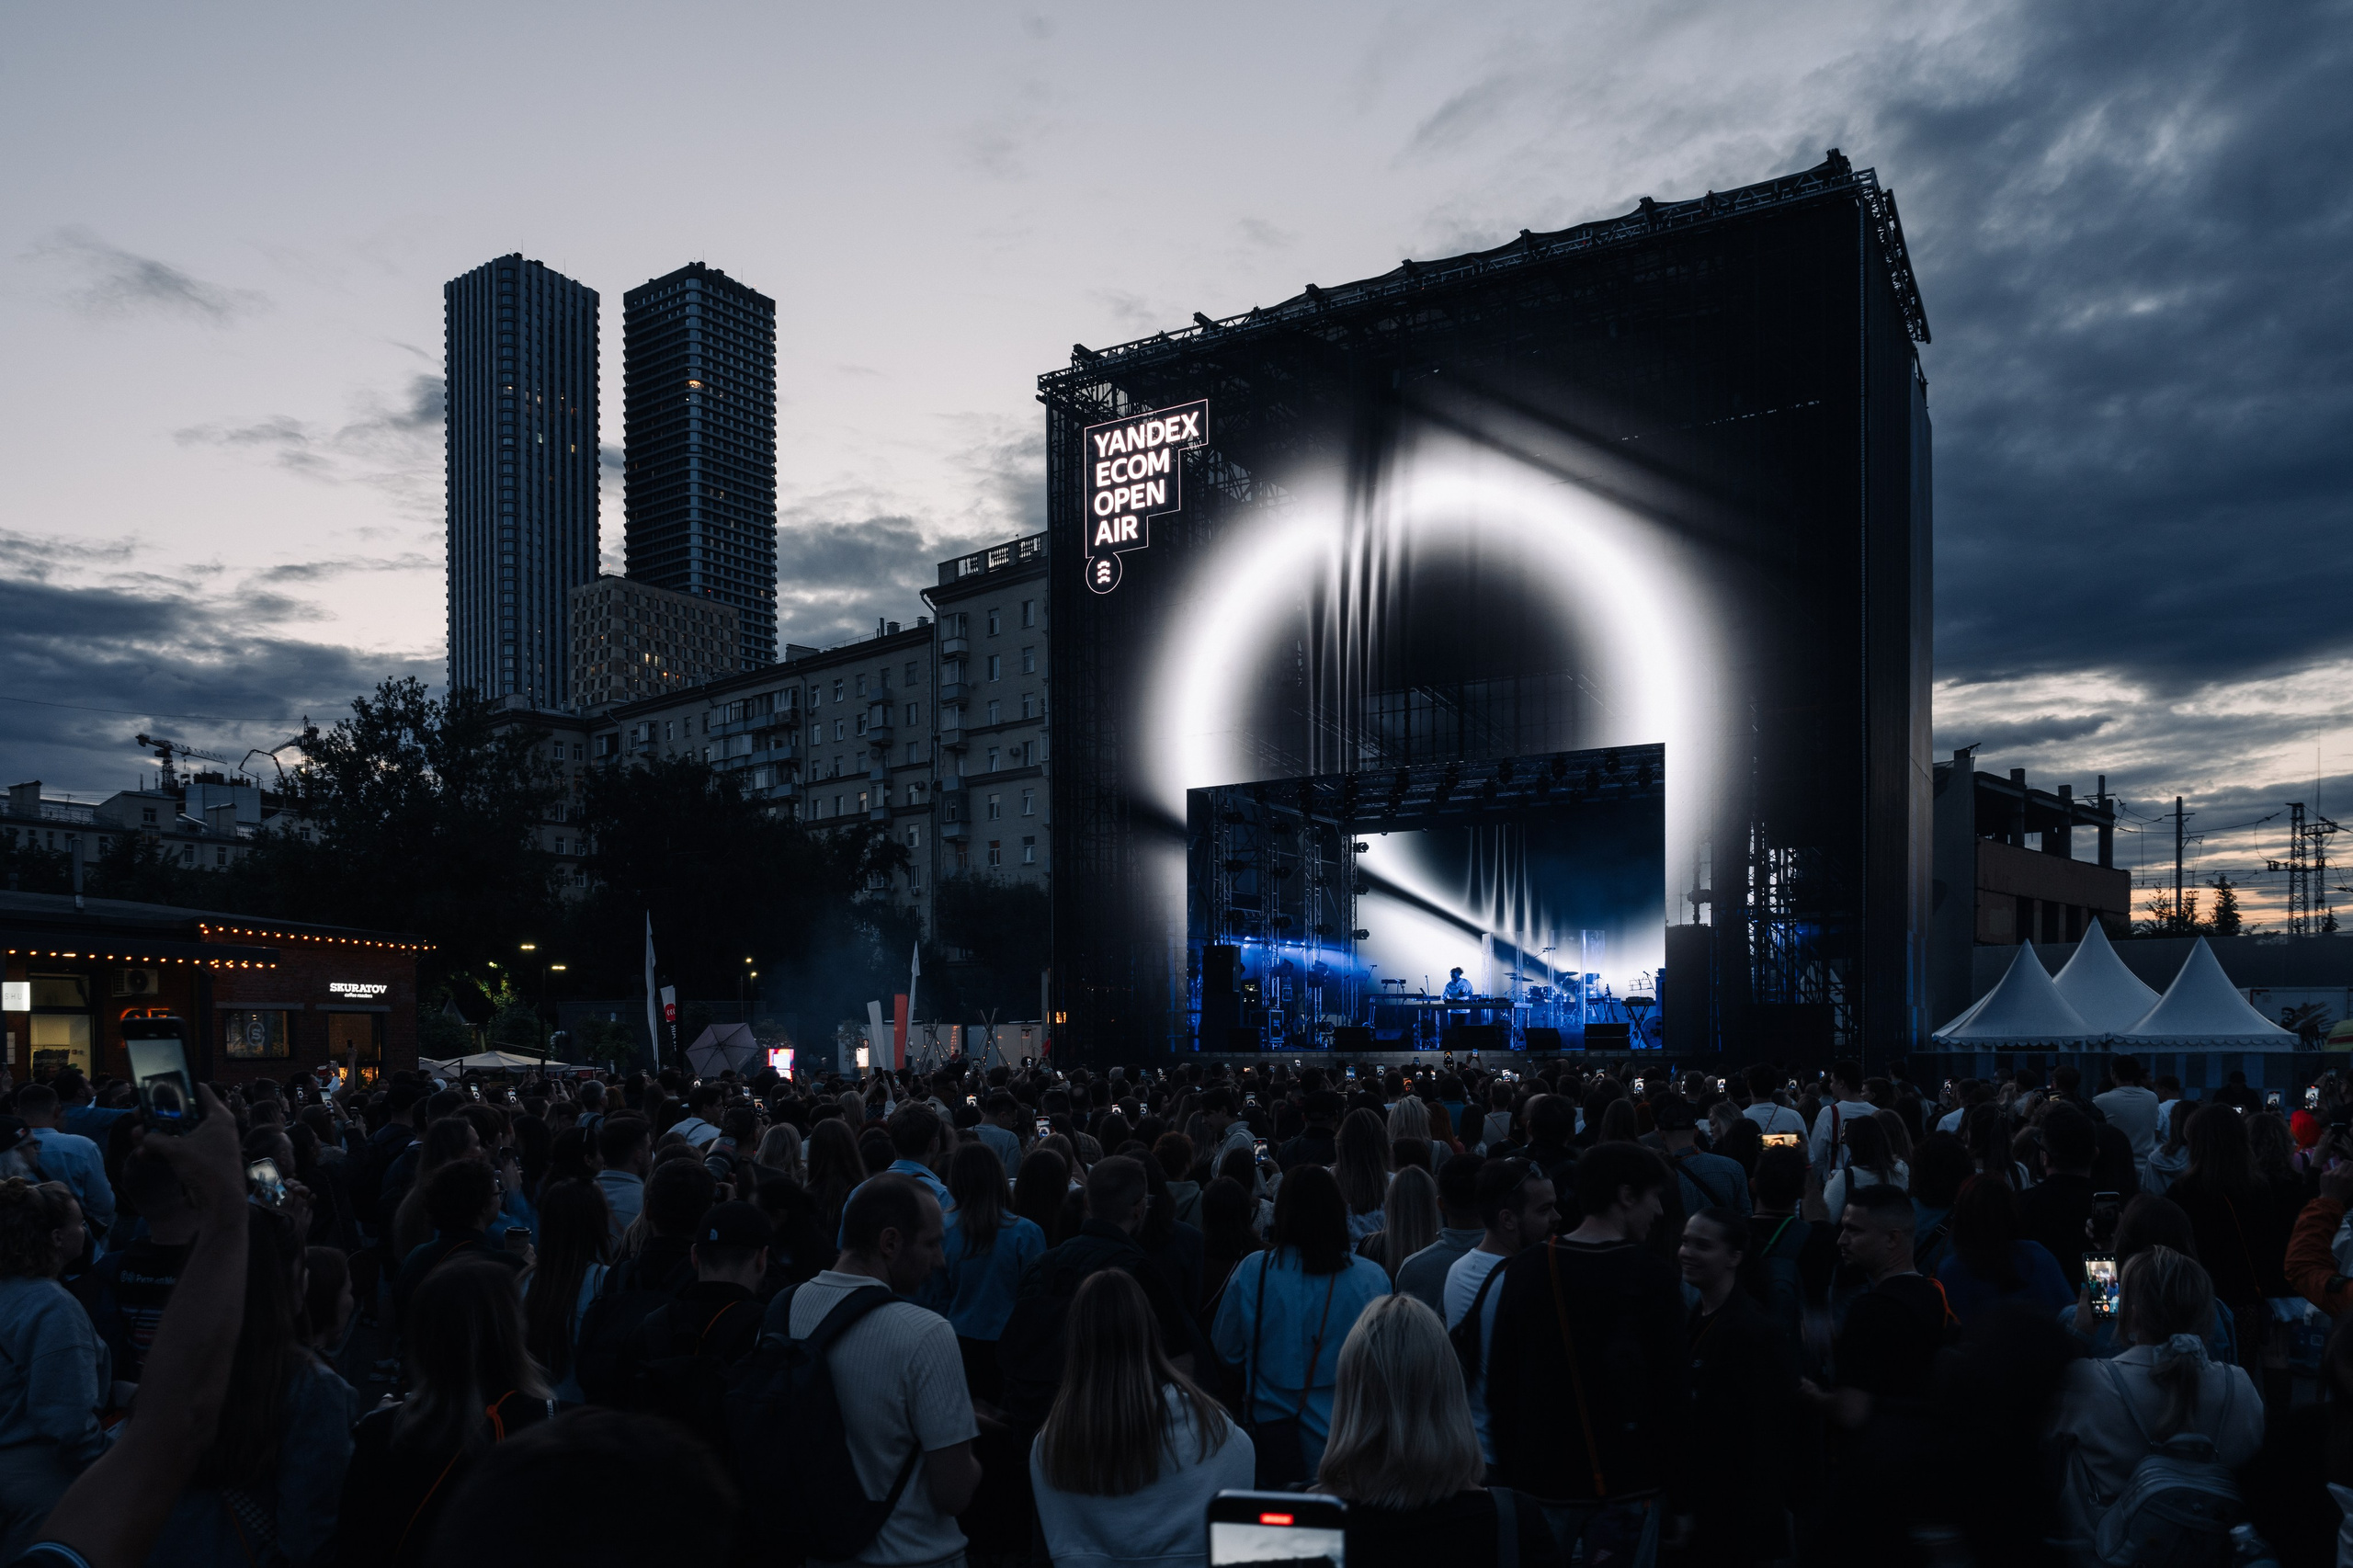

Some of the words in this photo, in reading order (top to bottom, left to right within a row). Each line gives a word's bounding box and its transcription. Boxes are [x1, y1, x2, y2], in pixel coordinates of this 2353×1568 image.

[1094, 412, 1199, 458] YANDEX
[1096, 448, 1170, 487] ECOM
[1094, 479, 1165, 517] OPEN
[1095, 515, 1138, 546] AIR
[330, 983, 387, 994] SKURATOV
